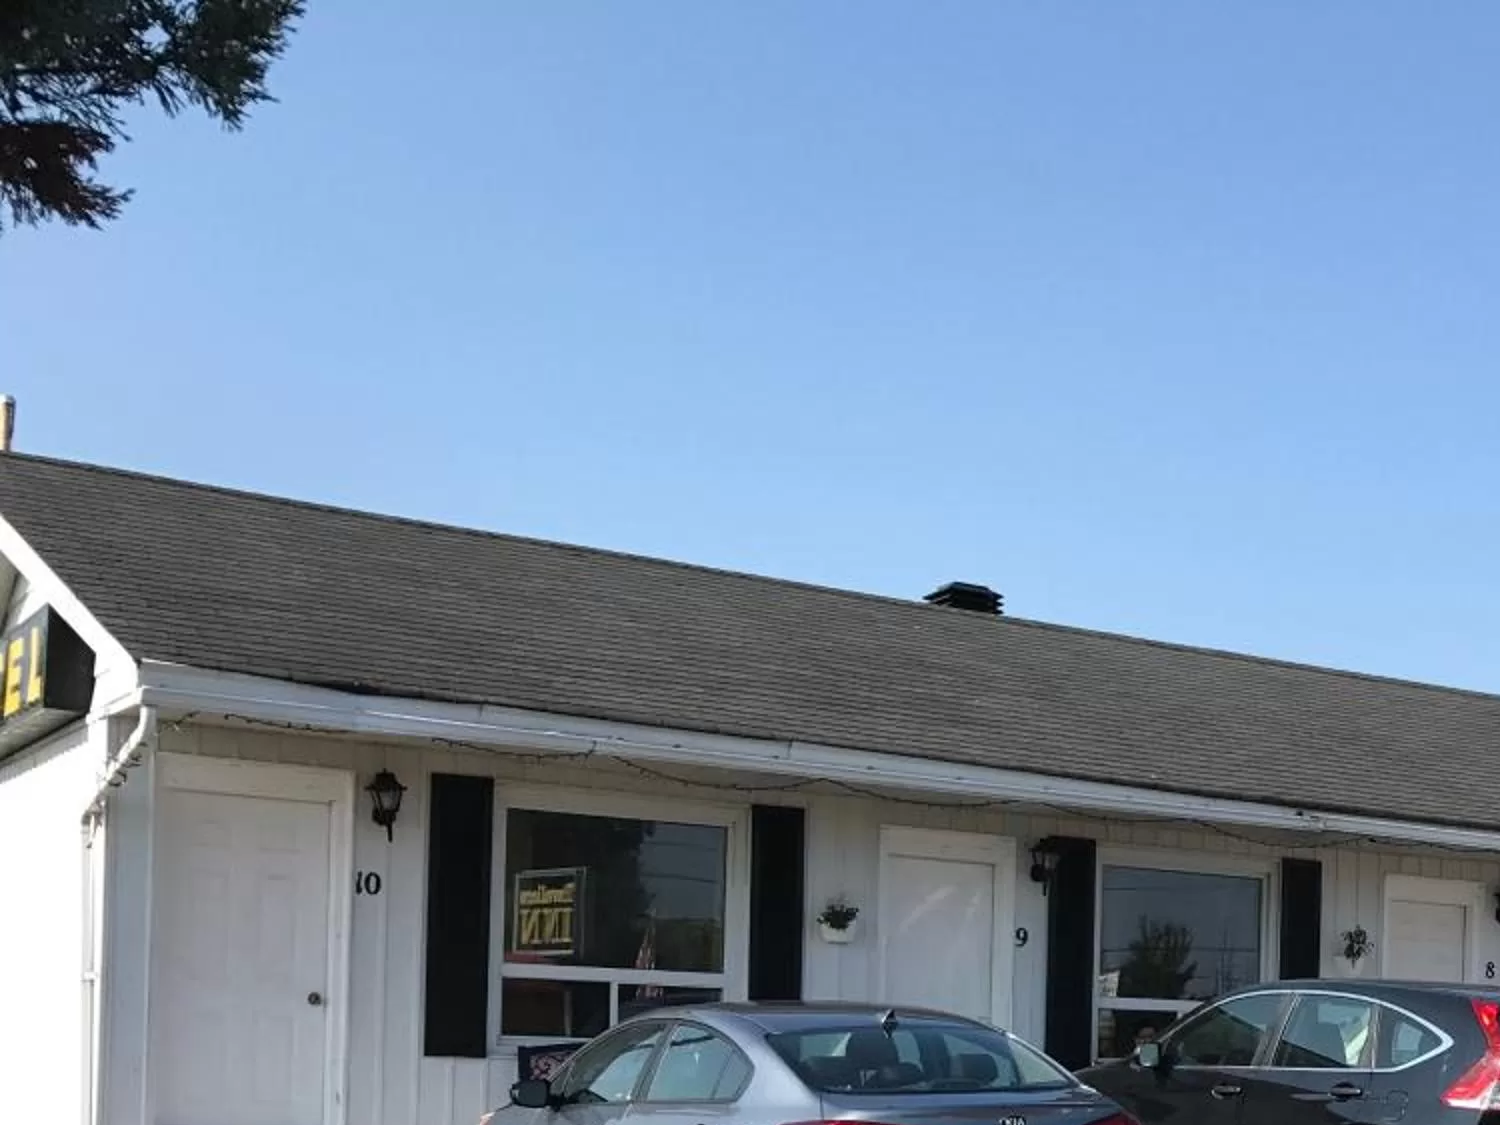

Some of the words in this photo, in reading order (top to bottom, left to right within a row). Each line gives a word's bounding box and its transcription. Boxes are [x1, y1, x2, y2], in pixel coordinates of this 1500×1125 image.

[0, 627, 42, 717] EL
[356, 870, 382, 895] 10
[1015, 927, 1029, 947] 9
[1485, 960, 1495, 979] 8
